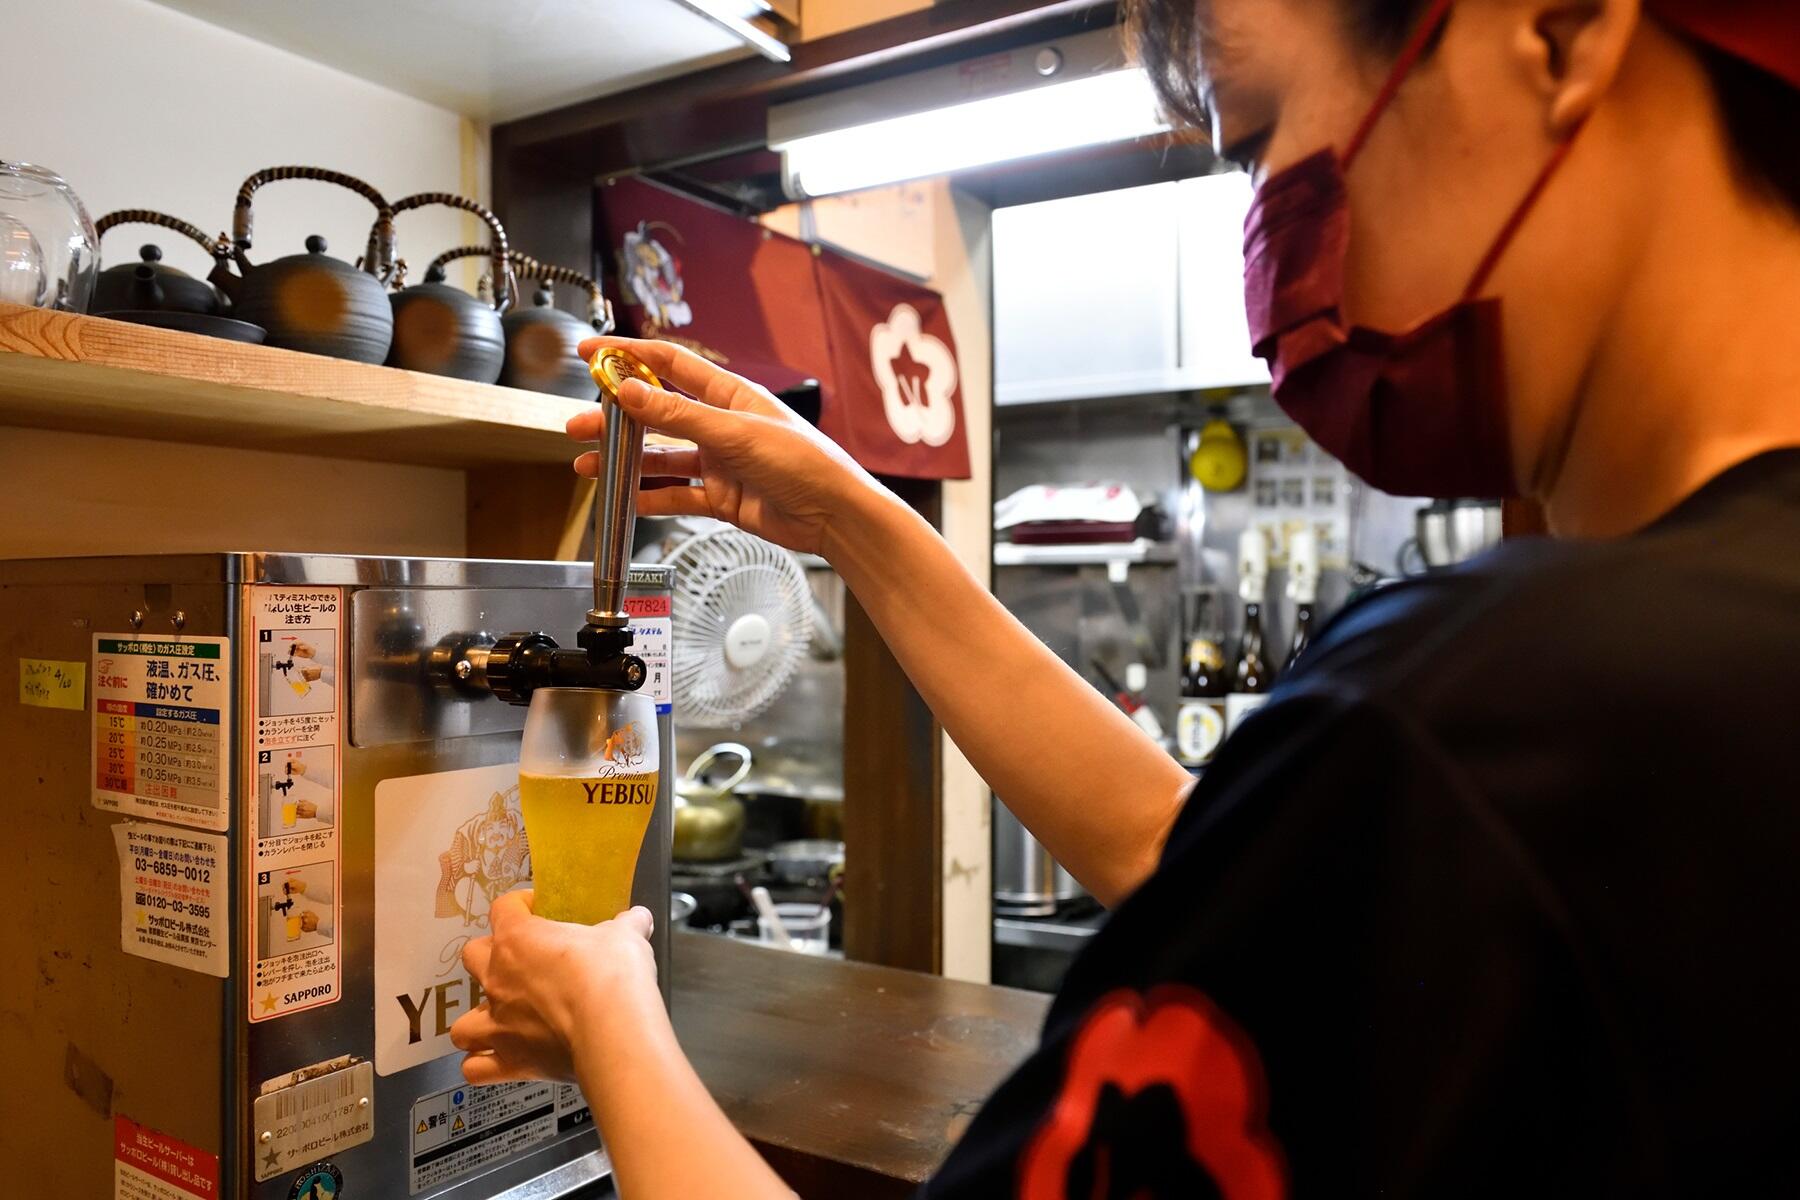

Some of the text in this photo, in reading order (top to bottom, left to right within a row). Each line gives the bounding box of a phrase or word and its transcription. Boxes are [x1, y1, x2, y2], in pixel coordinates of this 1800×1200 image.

[627, 572, 663, 584] HIZAKI
[284, 614, 311, 625] 注ぎ方
[262, 631, 269, 641] 1
[146, 660, 221, 682] 液温、ガス圧、
[146, 682, 193, 702] 確かめて
[261, 752, 268, 762] 2
[598, 764, 649, 781] Premium
[581, 783, 655, 805] YEBISU
[263, 840, 326, 857] カランレバーを閉じる
[135, 857, 210, 883] 03-6859-0012
[261, 873, 268, 883] 3
[146, 894, 210, 919] 0120-03-3595
[148, 914, 210, 938] サッポロビール株式会社
[284, 983, 332, 1005] SAPPORO
[428, 1111, 448, 1130] 警告
